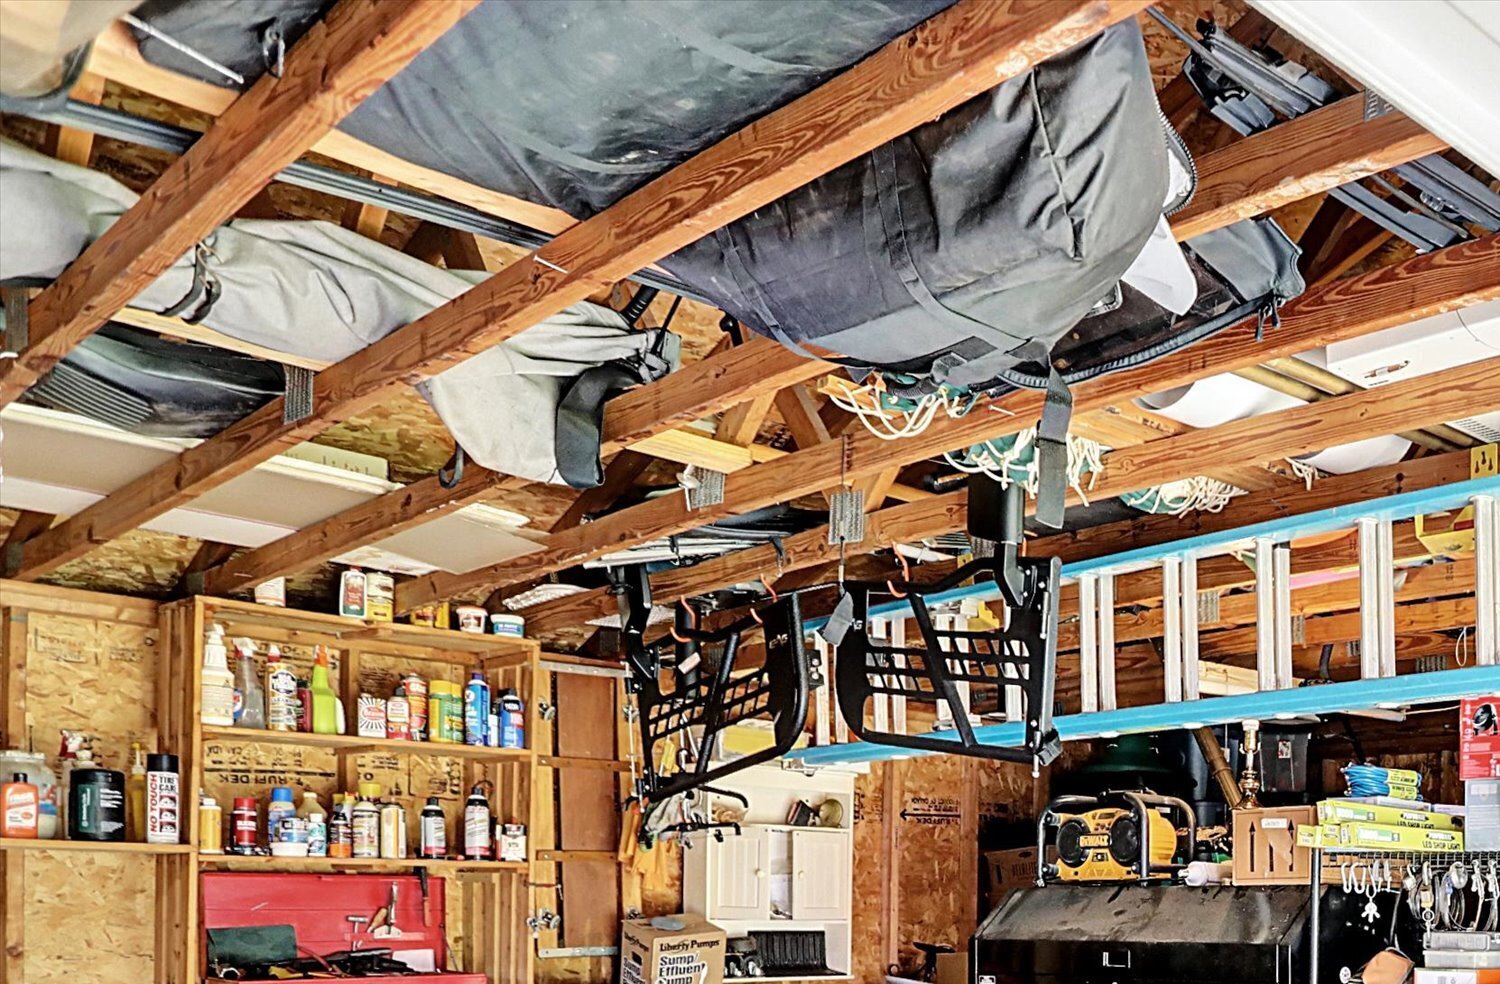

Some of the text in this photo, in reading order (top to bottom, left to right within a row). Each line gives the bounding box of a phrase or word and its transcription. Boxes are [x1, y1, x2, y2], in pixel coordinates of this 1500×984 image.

[150, 773, 158, 833] NO TOUCH
[1422, 841, 1461, 851] LED SHOP LIGHT
[659, 939, 720, 953] Liberty Pumps
